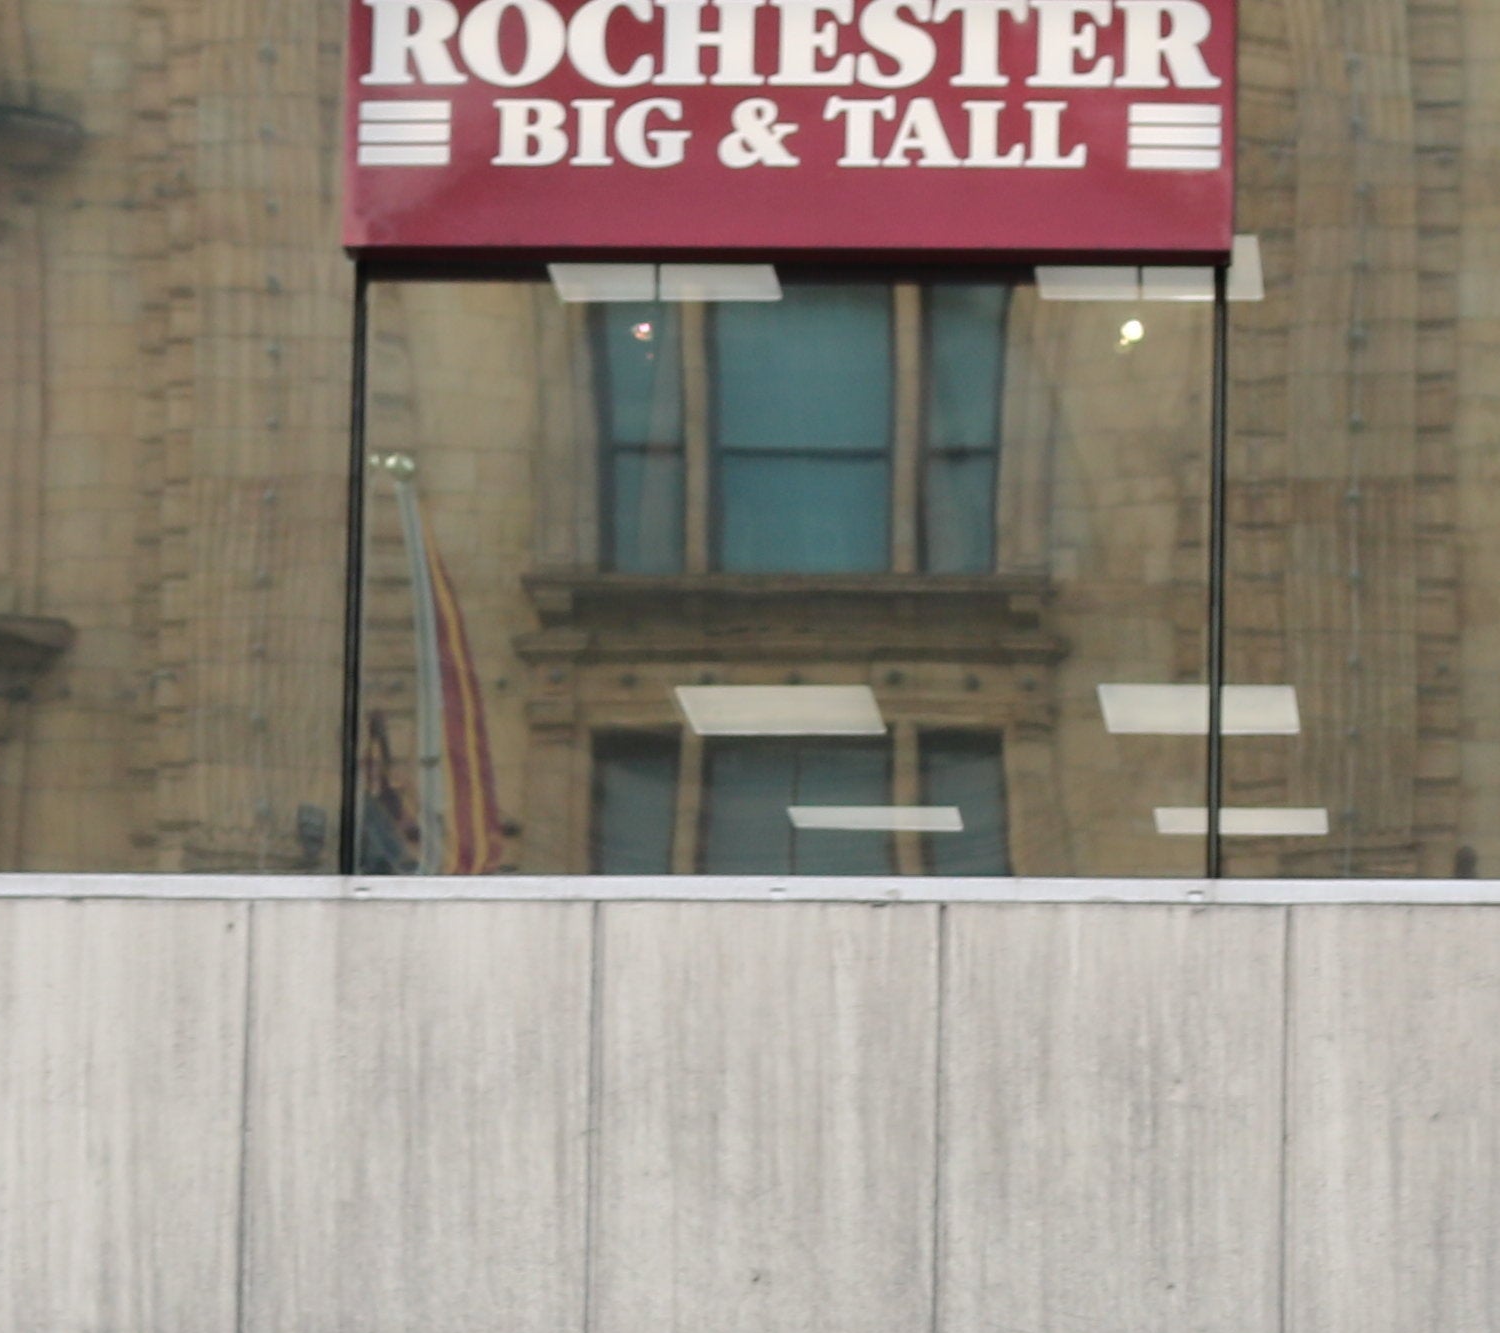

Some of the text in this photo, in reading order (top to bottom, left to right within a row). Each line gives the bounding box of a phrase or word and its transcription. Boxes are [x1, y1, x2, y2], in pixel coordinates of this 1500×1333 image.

[360, 0, 1222, 87] ROCHESTER
[492, 95, 1086, 170] BIG & TALL
